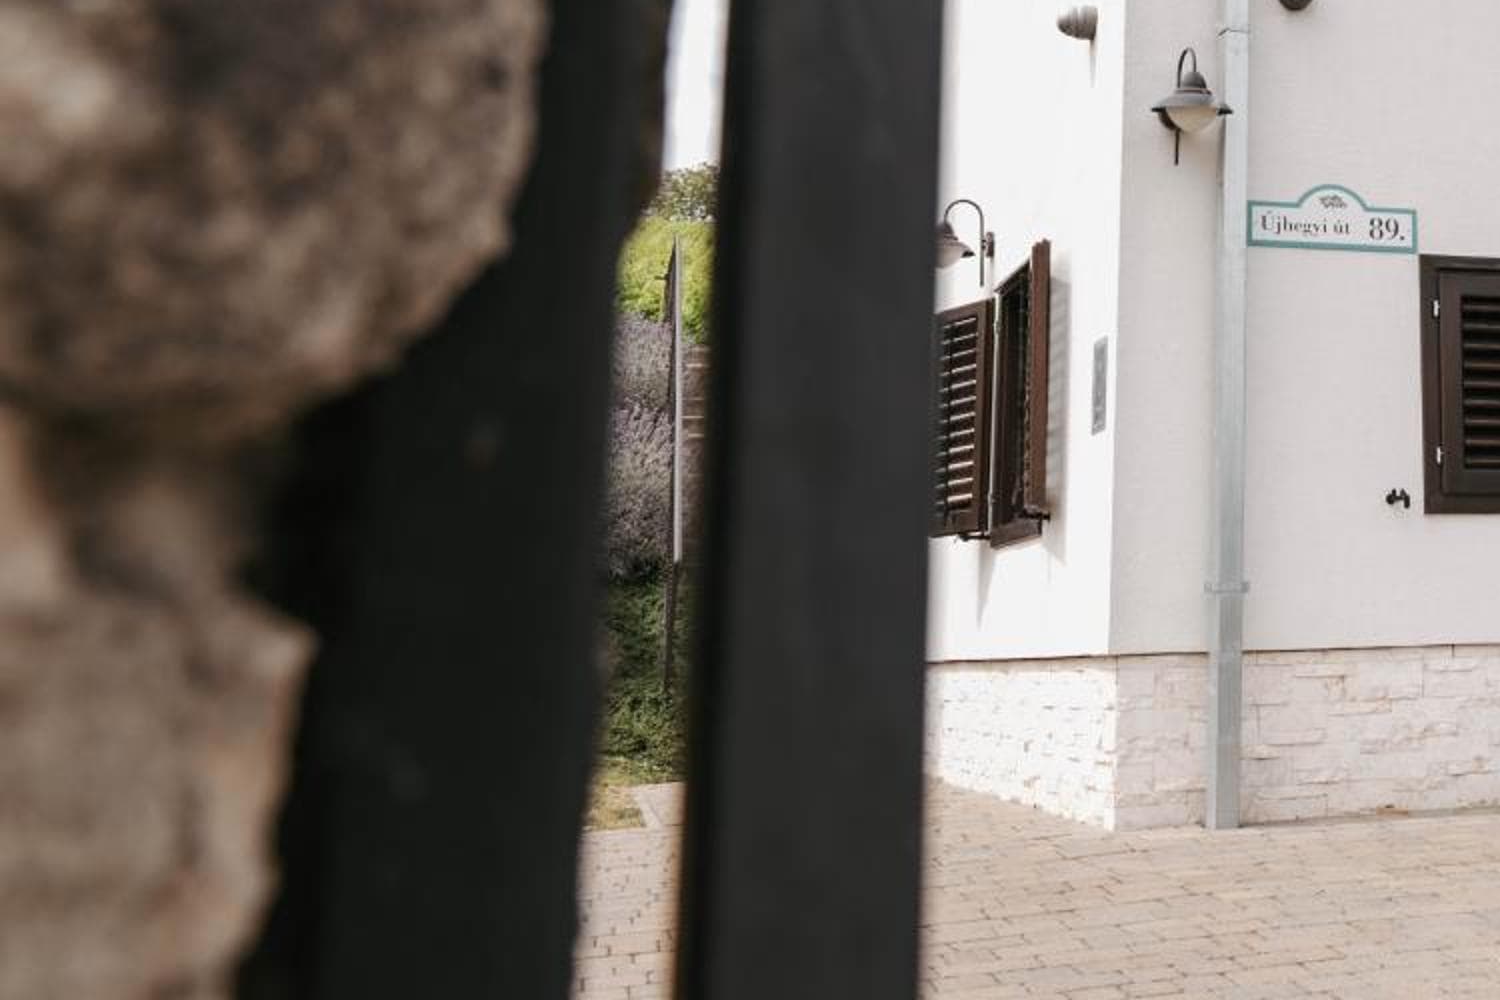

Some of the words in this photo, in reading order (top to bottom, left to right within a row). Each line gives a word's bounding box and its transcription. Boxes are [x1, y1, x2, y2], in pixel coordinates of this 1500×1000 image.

[1261, 210, 1327, 237] Újhegyi
[1333, 218, 1350, 234] út
[1369, 217, 1405, 241] 89.
